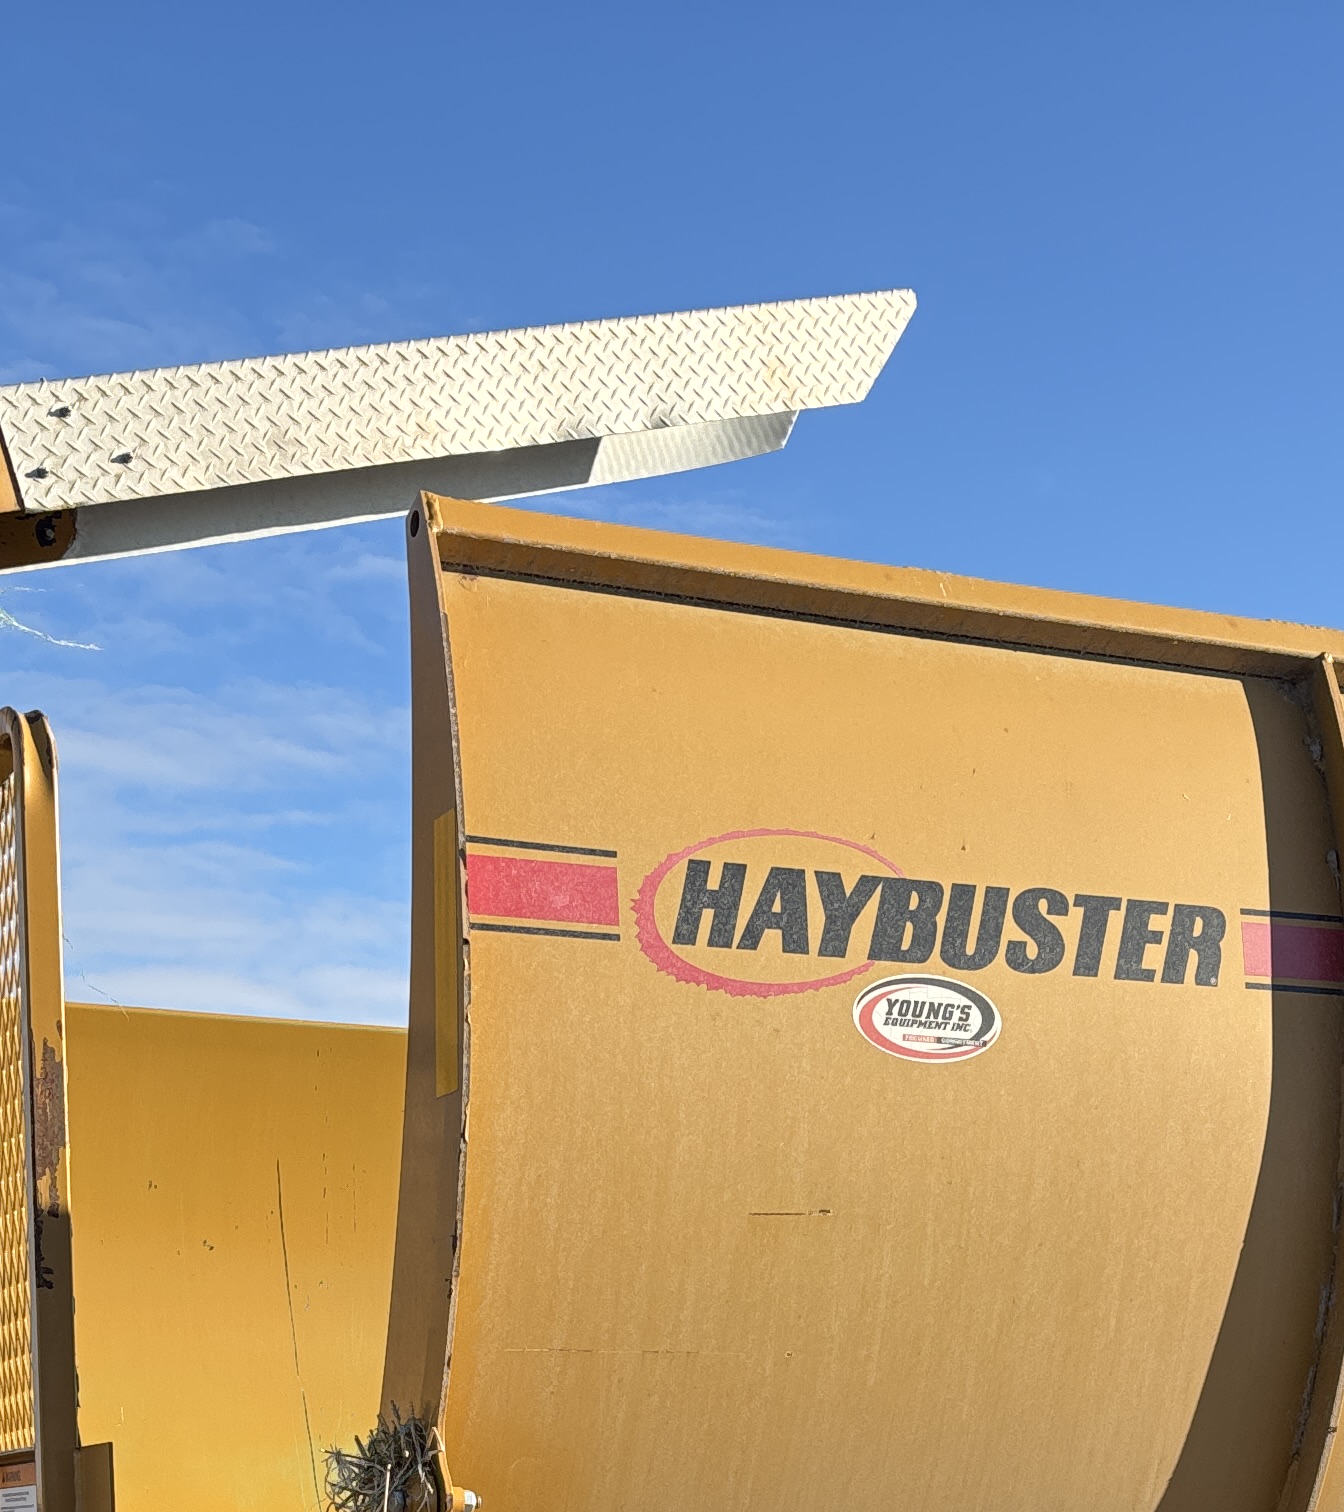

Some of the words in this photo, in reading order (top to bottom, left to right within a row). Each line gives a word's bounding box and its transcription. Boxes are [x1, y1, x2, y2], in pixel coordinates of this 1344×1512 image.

[671, 860, 1229, 988] HAYBUSTER
[885, 998, 972, 1022] YOUNG'S
[883, 1016, 950, 1030] EQUIPMENT
